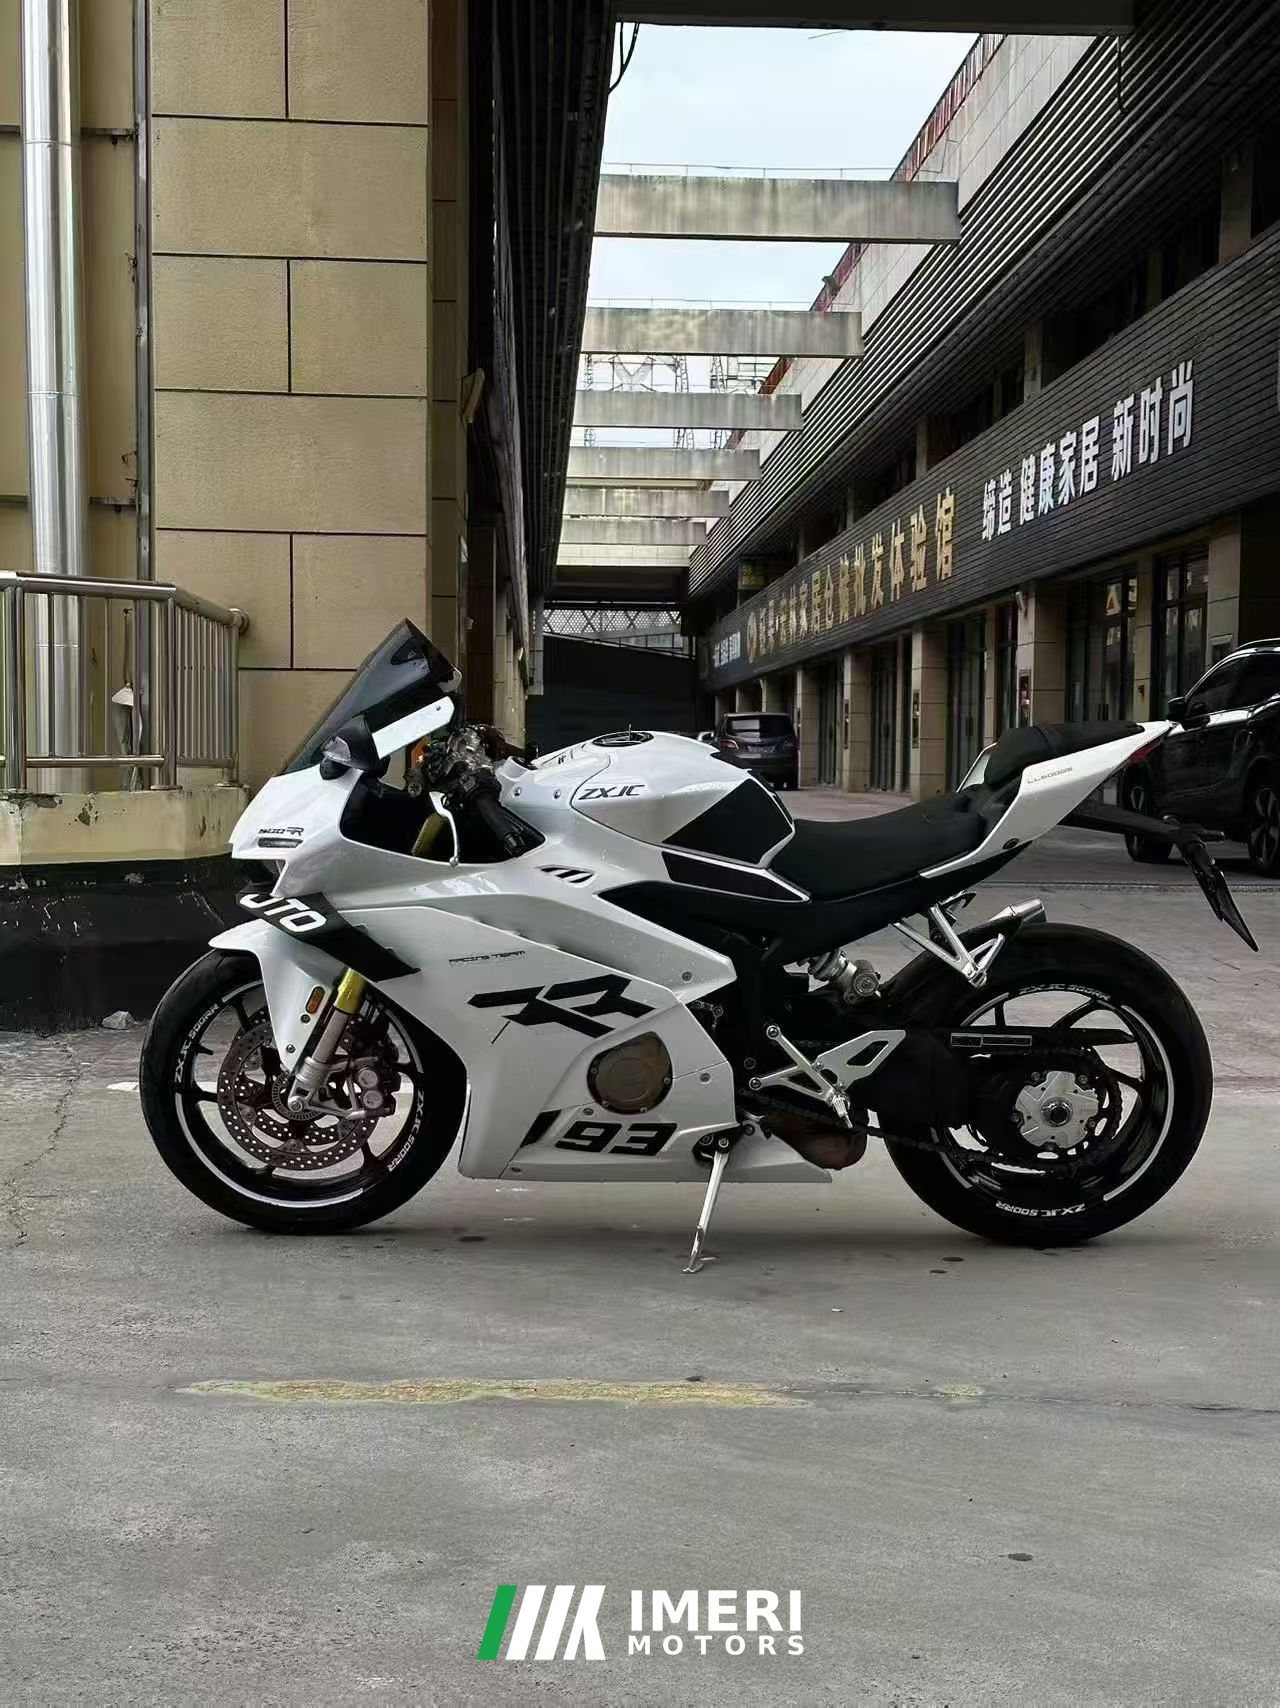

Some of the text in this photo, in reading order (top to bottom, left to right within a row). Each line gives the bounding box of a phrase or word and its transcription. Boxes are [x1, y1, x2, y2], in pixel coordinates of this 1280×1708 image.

[1019, 415, 1101, 526] 健康家居
[1110, 359, 1194, 482] 新时尚
[578, 784, 646, 800] ZXJC
[491, 950, 526, 959] TEAM
[174, 1040, 192, 1083] ZXJC
[411, 1090, 424, 1134] ZXJC
[1040, 1203, 1086, 1217] ZXJC
